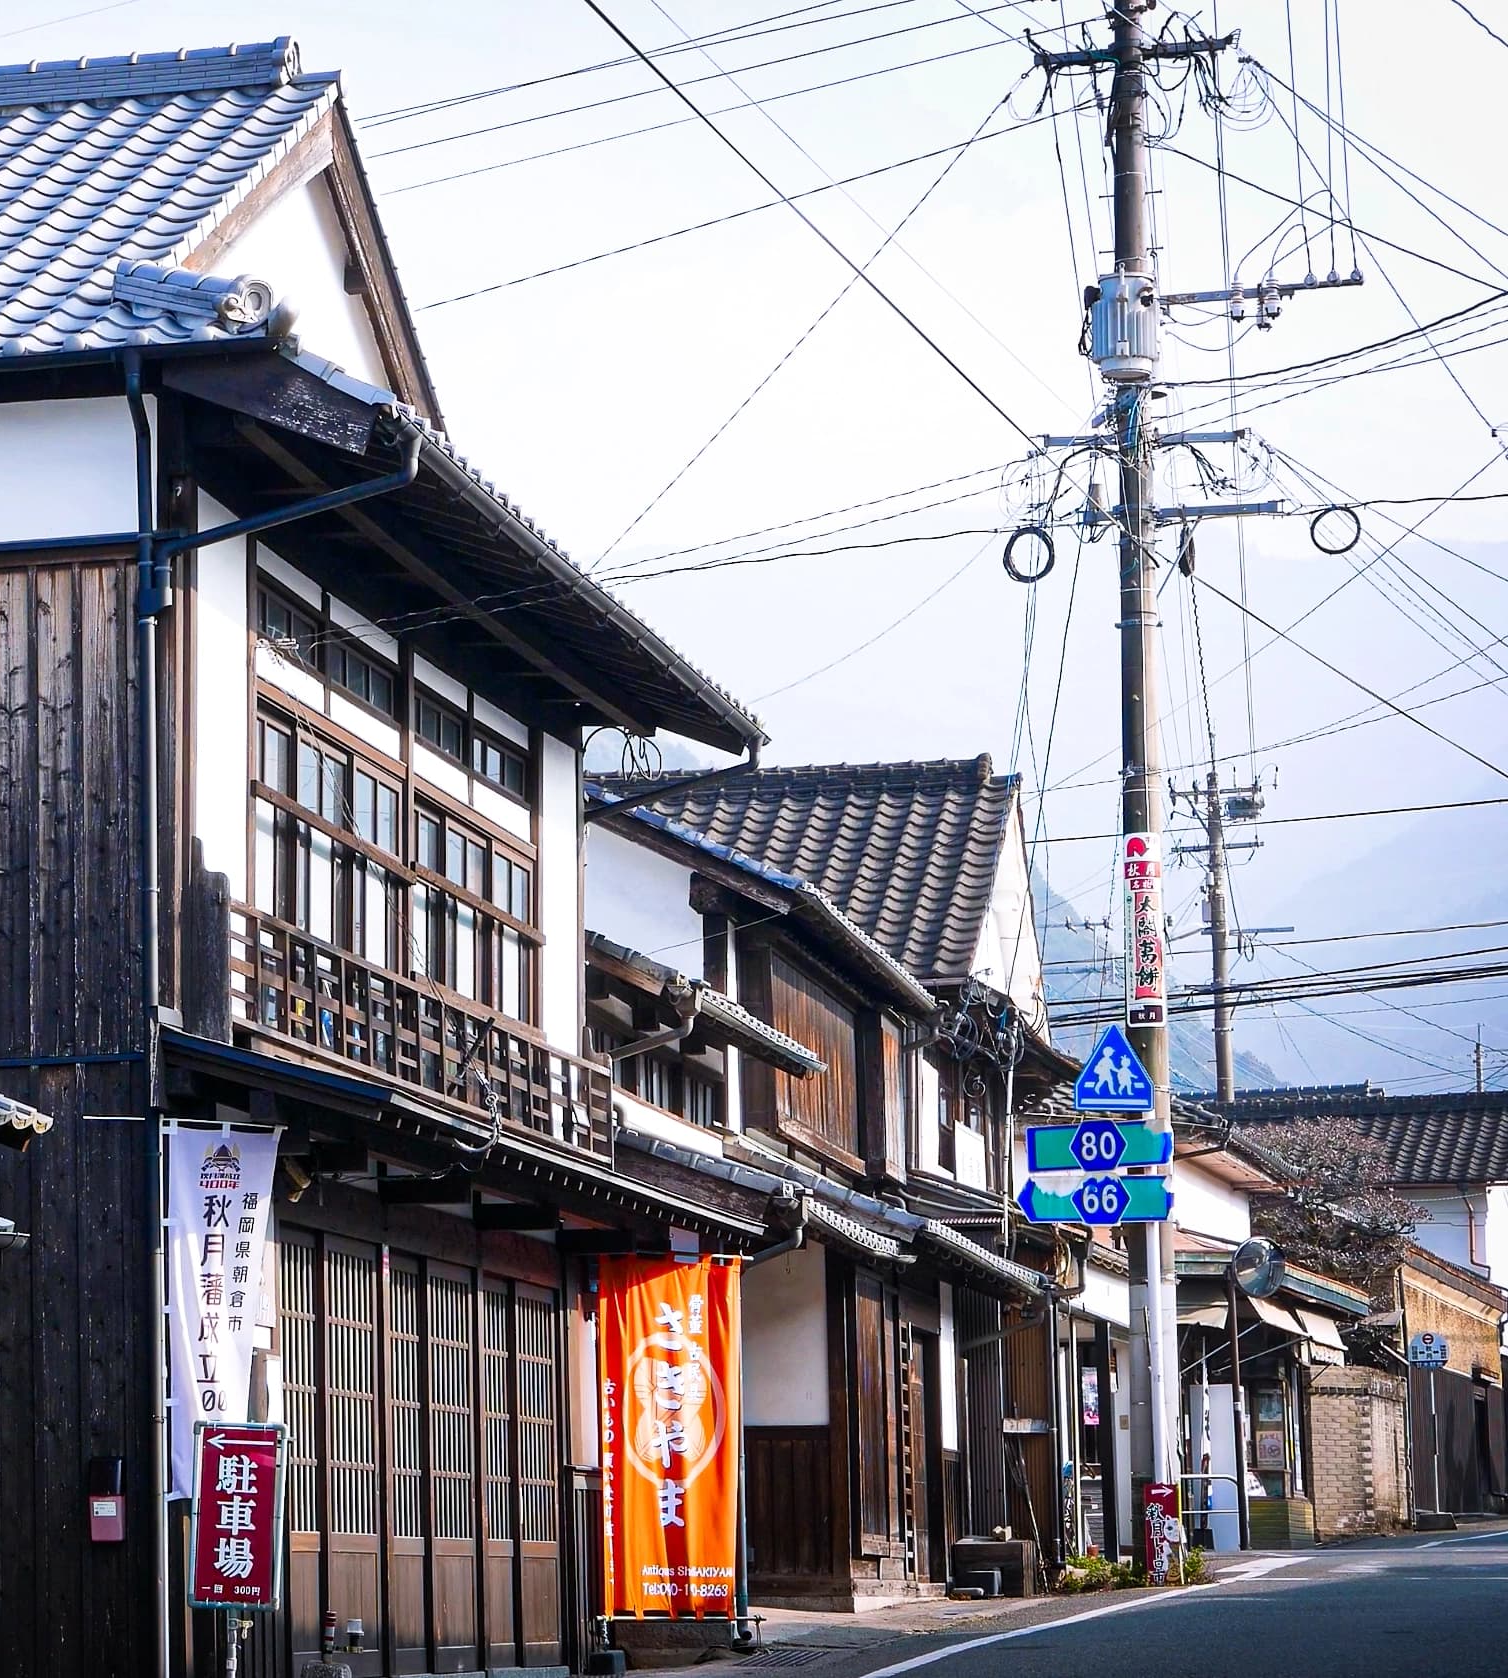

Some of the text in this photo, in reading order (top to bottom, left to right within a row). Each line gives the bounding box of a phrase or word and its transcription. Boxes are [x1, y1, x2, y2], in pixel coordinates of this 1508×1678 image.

[1127, 863, 1156, 876] 秋月
[1138, 1012, 1156, 1021] 秋月
[1081, 1131, 1116, 1161] 80
[199, 1181, 240, 1189] 400年
[1083, 1184, 1118, 1213] 66
[228, 1192, 258, 1333] 福岡県朝倉市
[653, 1302, 688, 1528] さきやま
[214, 1454, 258, 1579] 駐車場
[201, 1584, 260, 1597] 一回 300円
